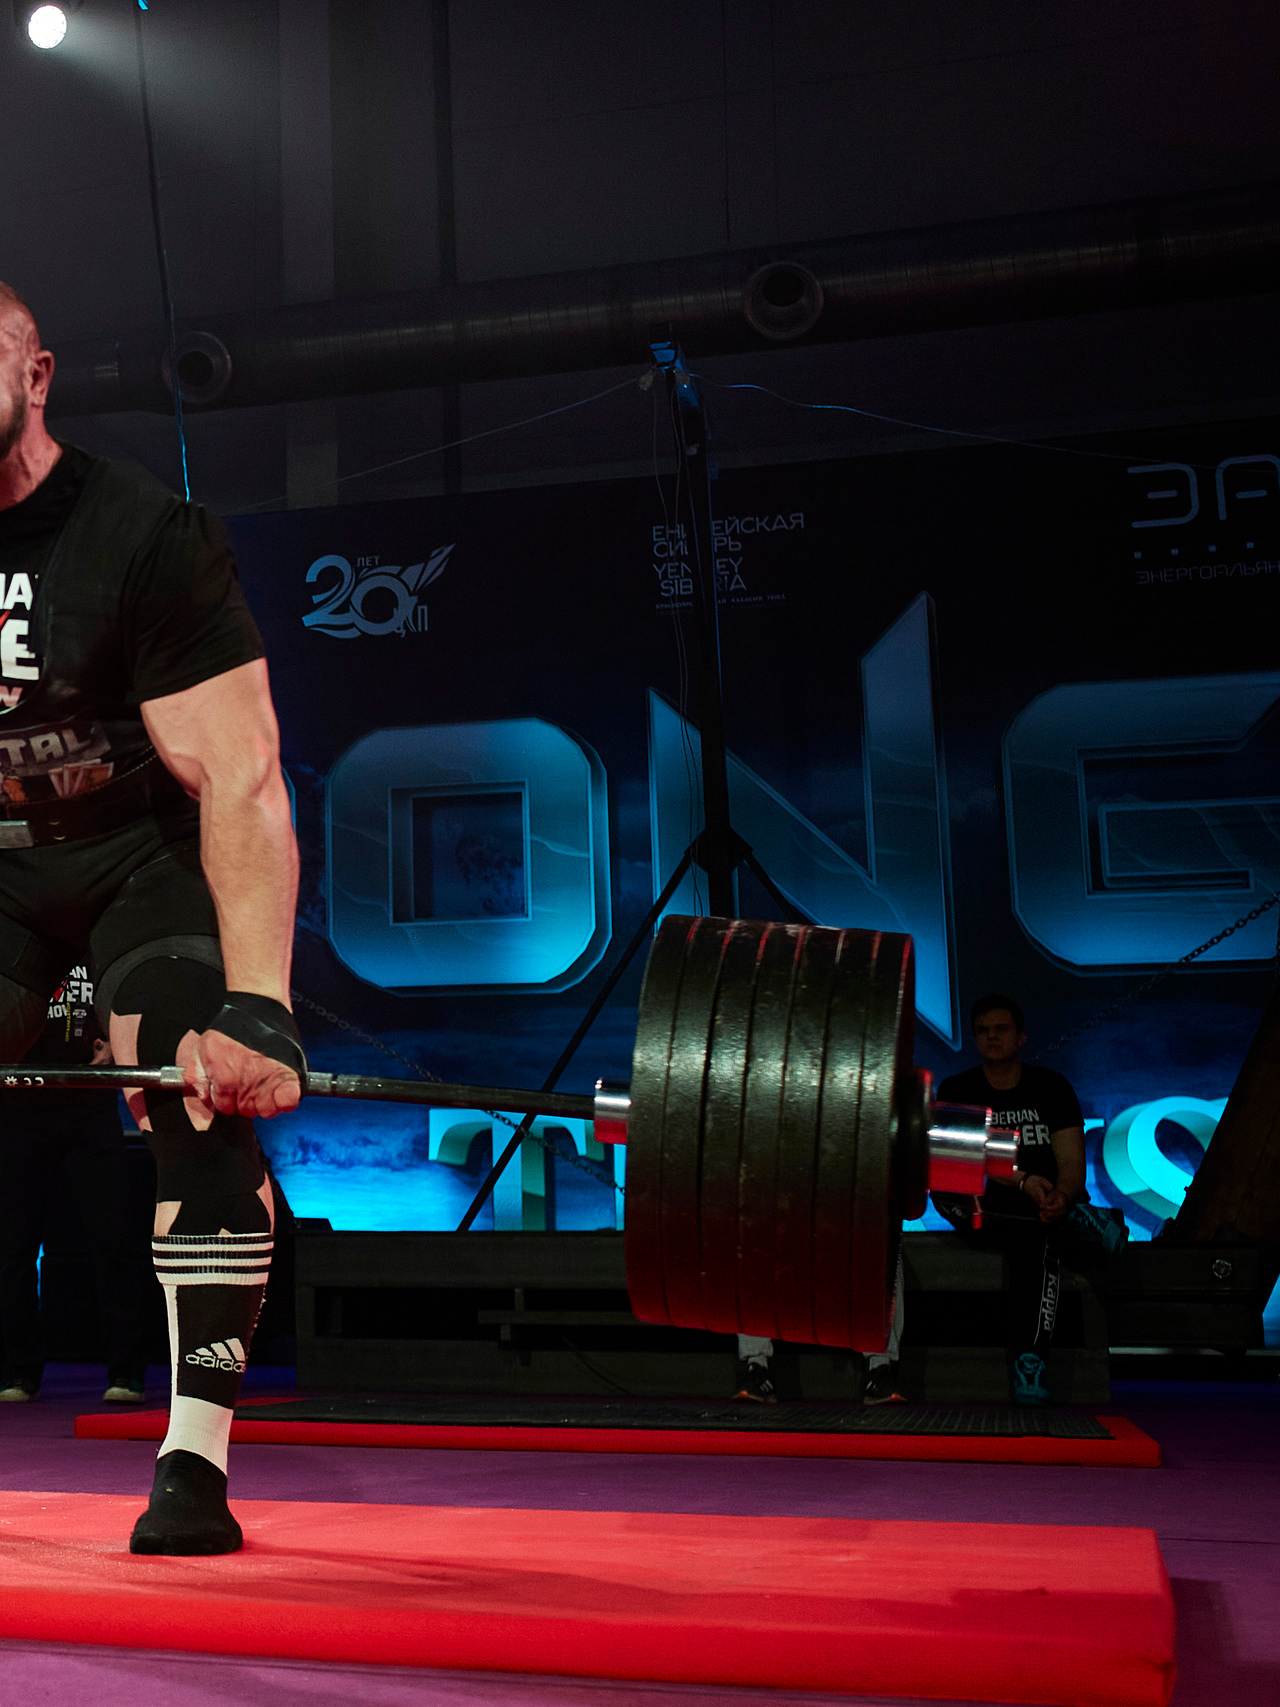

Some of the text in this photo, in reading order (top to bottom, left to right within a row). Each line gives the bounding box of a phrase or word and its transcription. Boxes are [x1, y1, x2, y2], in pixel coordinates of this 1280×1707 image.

[652, 512, 805, 542] ЕНЕЙСКАЯ
[653, 535, 742, 558] СИРЬ
[356, 555, 380, 568] ЛЕТ
[652, 556, 743, 581] YENEY
[660, 573, 747, 597] SIBRIA
[991, 1108, 1040, 1126] BERIAN
[1042, 1271, 1059, 1332] Kappa
[185, 1352, 247, 1374] adida
